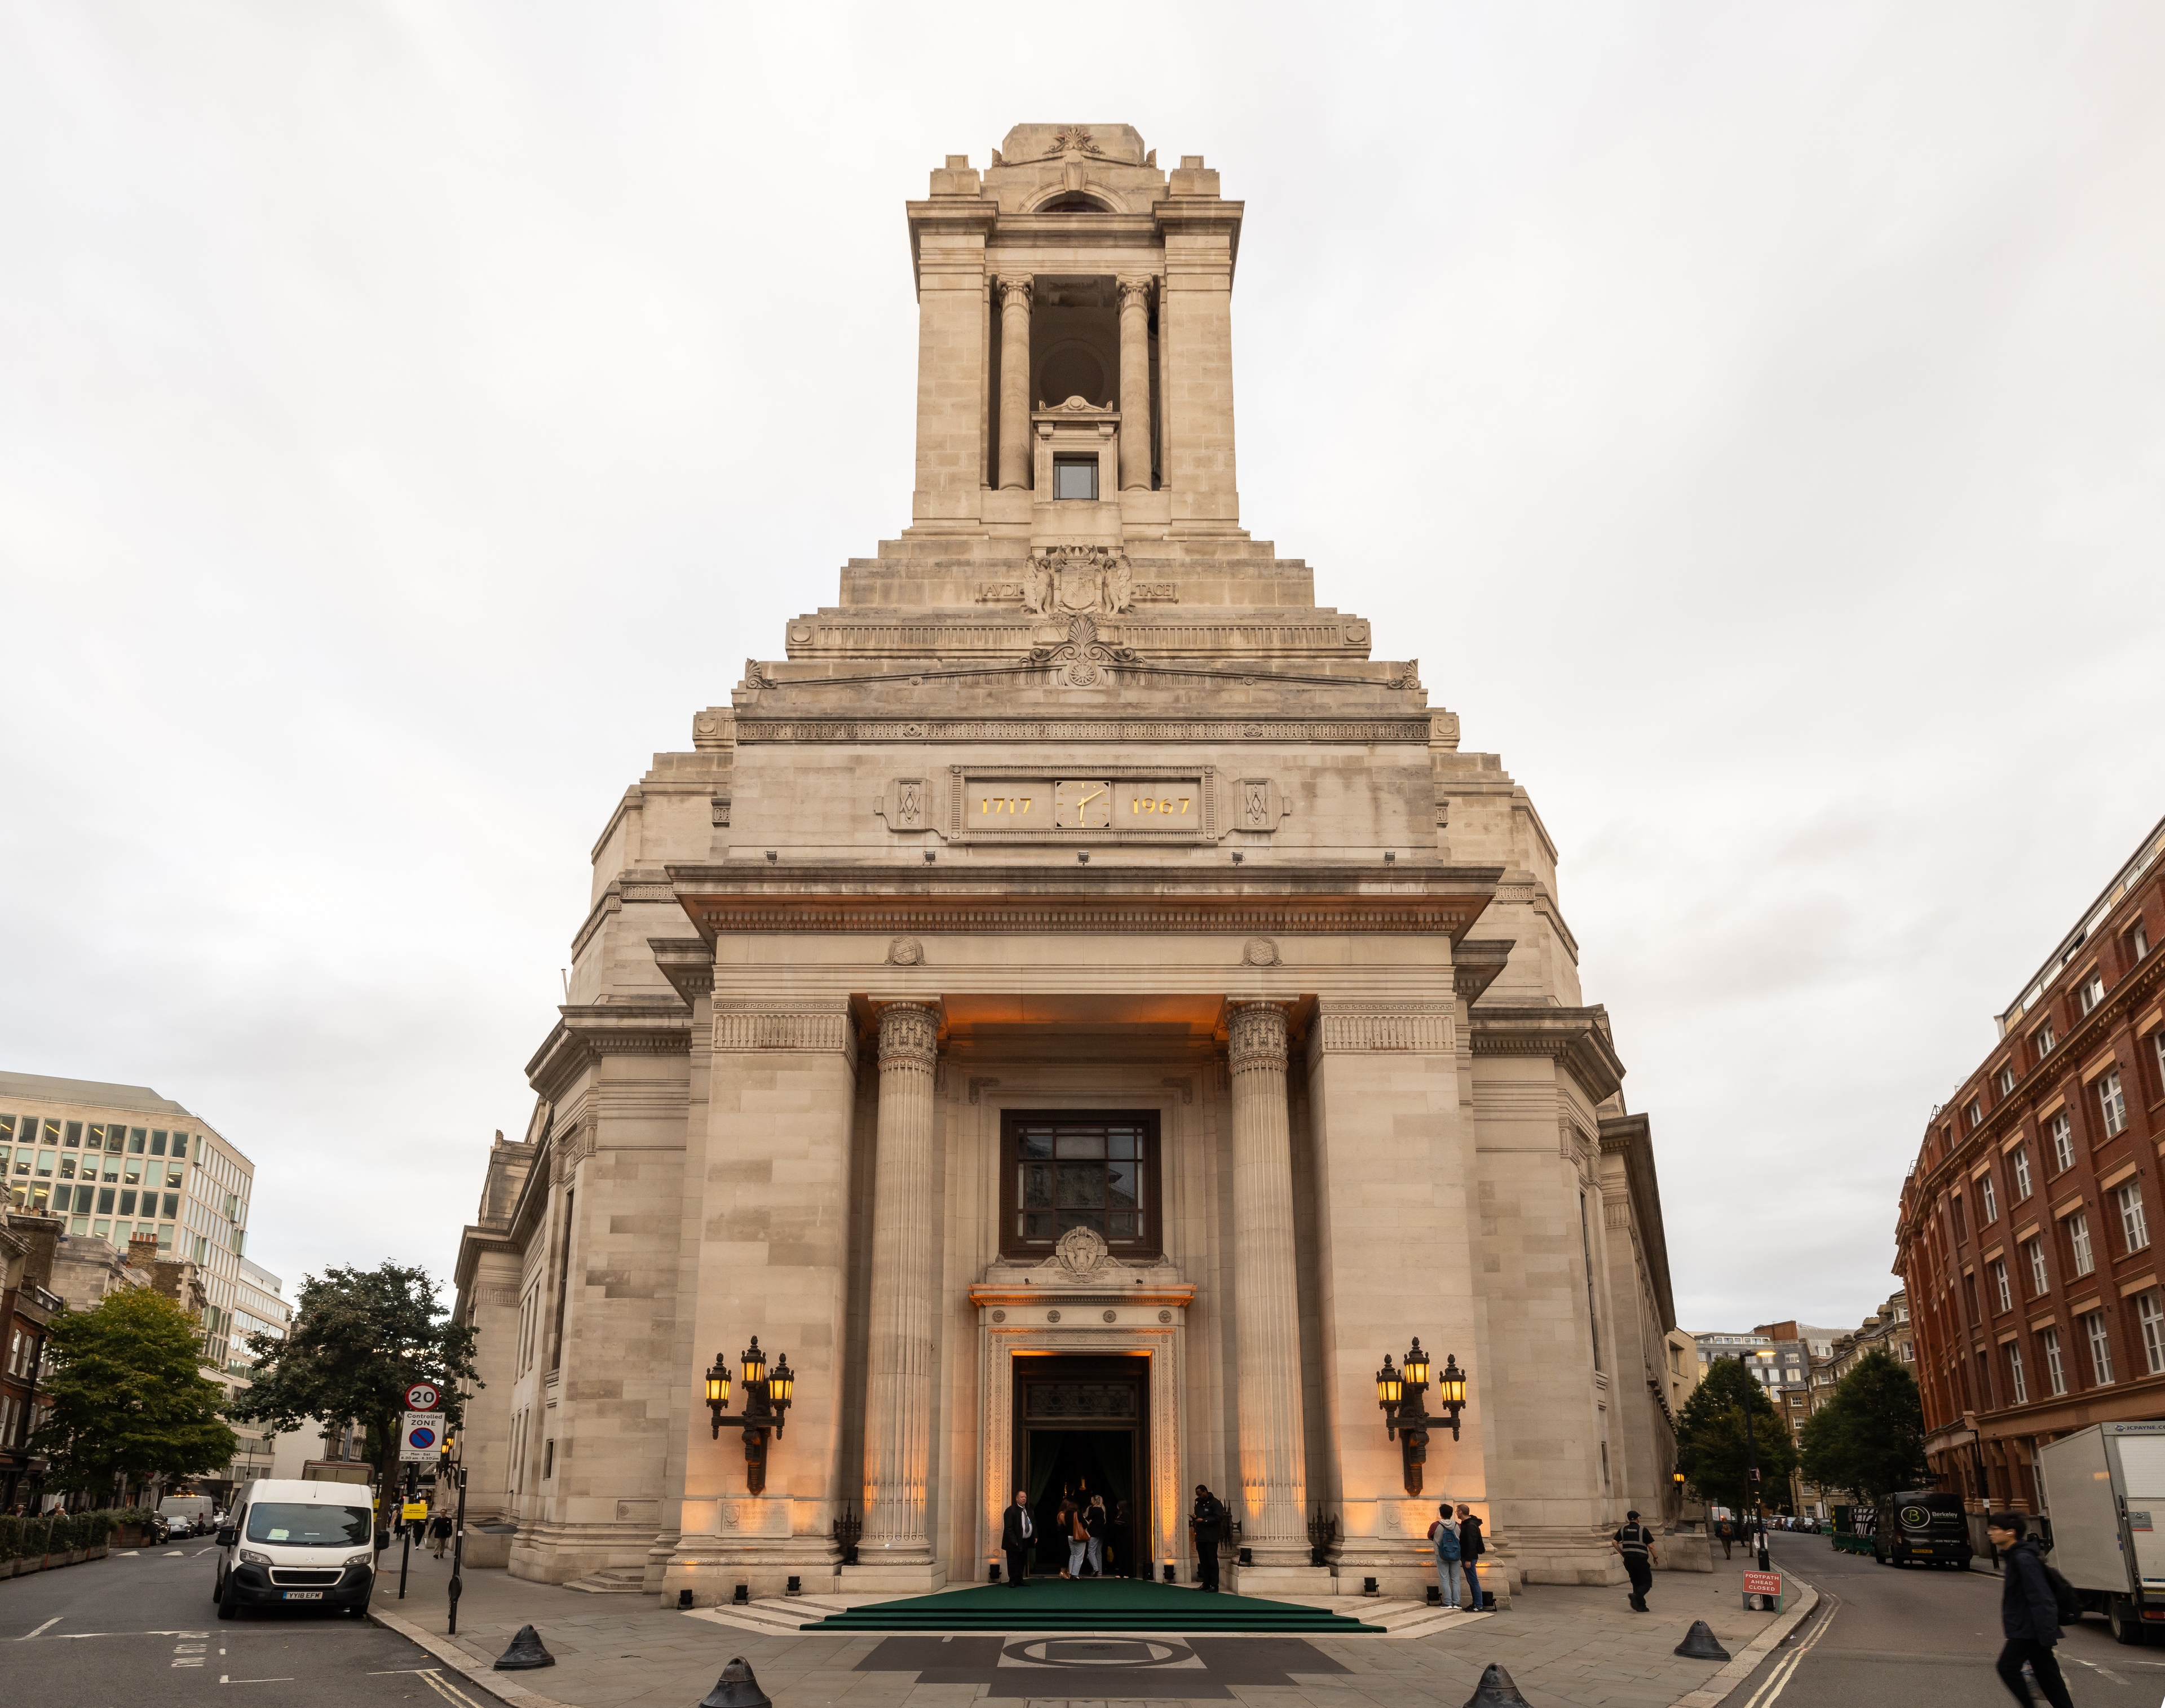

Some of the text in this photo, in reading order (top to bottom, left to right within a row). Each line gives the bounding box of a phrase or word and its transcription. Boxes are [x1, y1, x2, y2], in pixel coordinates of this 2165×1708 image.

[1135, 584, 1172, 597] TACE
[983, 798, 1032, 815] 1717
[1133, 798, 1190, 815] 1967
[411, 1391, 435, 1403] 20
[1907, 1510, 1920, 1521] B
